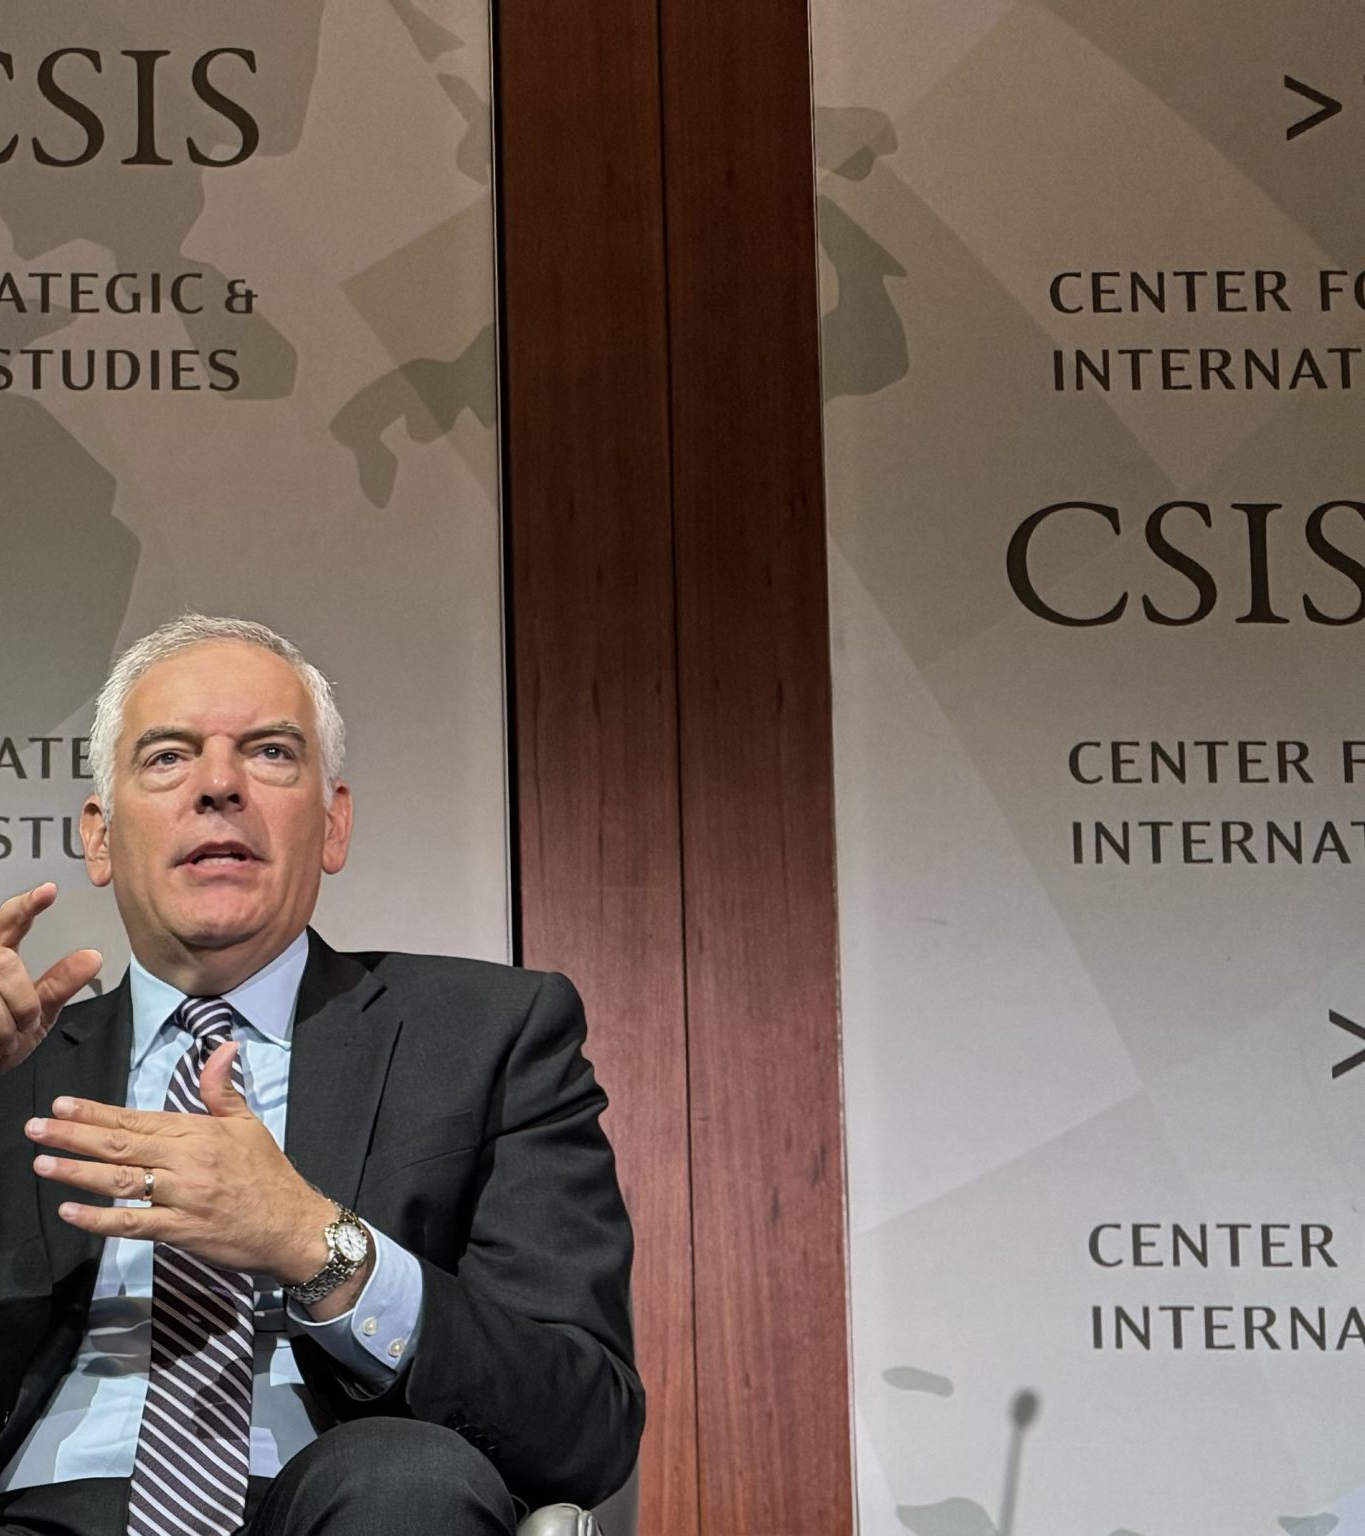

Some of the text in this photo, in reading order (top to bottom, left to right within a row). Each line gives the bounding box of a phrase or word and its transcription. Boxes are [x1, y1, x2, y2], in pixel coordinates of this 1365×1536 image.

[224, 279, 259, 314] &
[1049, 270, 1292, 314] CENTER
[1053, 347, 1362, 392] INTERNAT
[1007, 500, 1365, 627] CSIS
[1069, 741, 1314, 784] CENTER
[1072, 821, 1365, 865] INTERNA
[1088, 1223, 1338, 1268] CENTER
[1093, 1306, 1365, 1352] INTERNA
